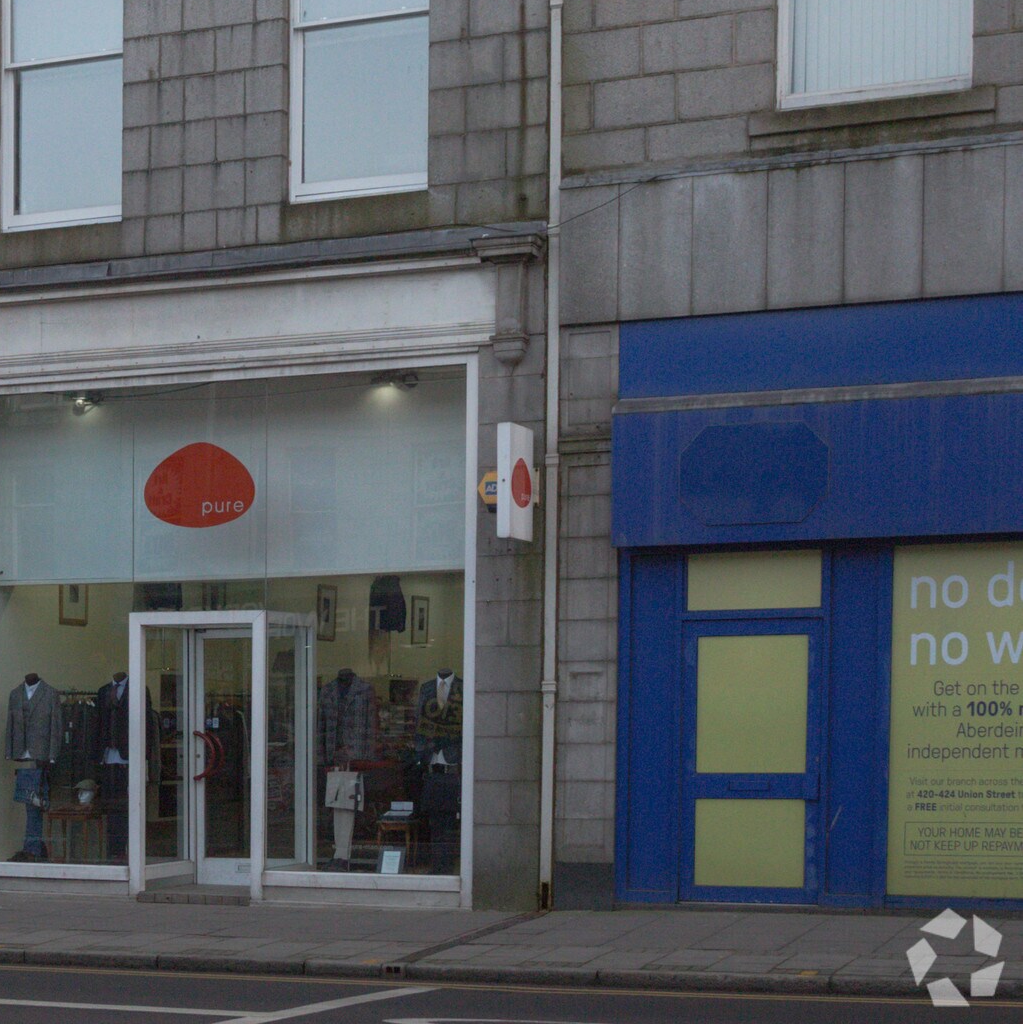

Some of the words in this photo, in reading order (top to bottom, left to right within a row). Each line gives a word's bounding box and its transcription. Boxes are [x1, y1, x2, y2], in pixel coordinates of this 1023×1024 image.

[202, 500, 244, 516] pure
[910, 574, 969, 609] no
[987, 560, 1023, 608] d
[910, 631, 969, 665] no
[933, 680, 961, 696] Get
[966, 683, 987, 696] on
[992, 680, 1020, 696] the
[912, 701, 947, 717] with
[952, 705, 961, 717] a
[966, 701, 1013, 716] 100%
[907, 743, 1010, 762] independent
[909, 777, 928, 786] Visit
[930, 778, 944, 786] our
[946, 777, 977, 786] branch
[978, 778, 1008, 786] across
[906, 790, 915, 799] at
[917, 790, 955, 799] 420-424
[957, 790, 984, 799] Union
[985, 789, 1016, 799] Street
[914, 802, 937, 812] FREE
[964, 803, 1019, 812] consultation
[917, 827, 947, 838] YOUR
[949, 827, 980, 838] HOME
[984, 827, 1007, 838] MAY
[1009, 828, 1023, 839] BE
[910, 840, 931, 851] NOT
[933, 840, 961, 851] KEEP
[963, 840, 978, 852] UP
